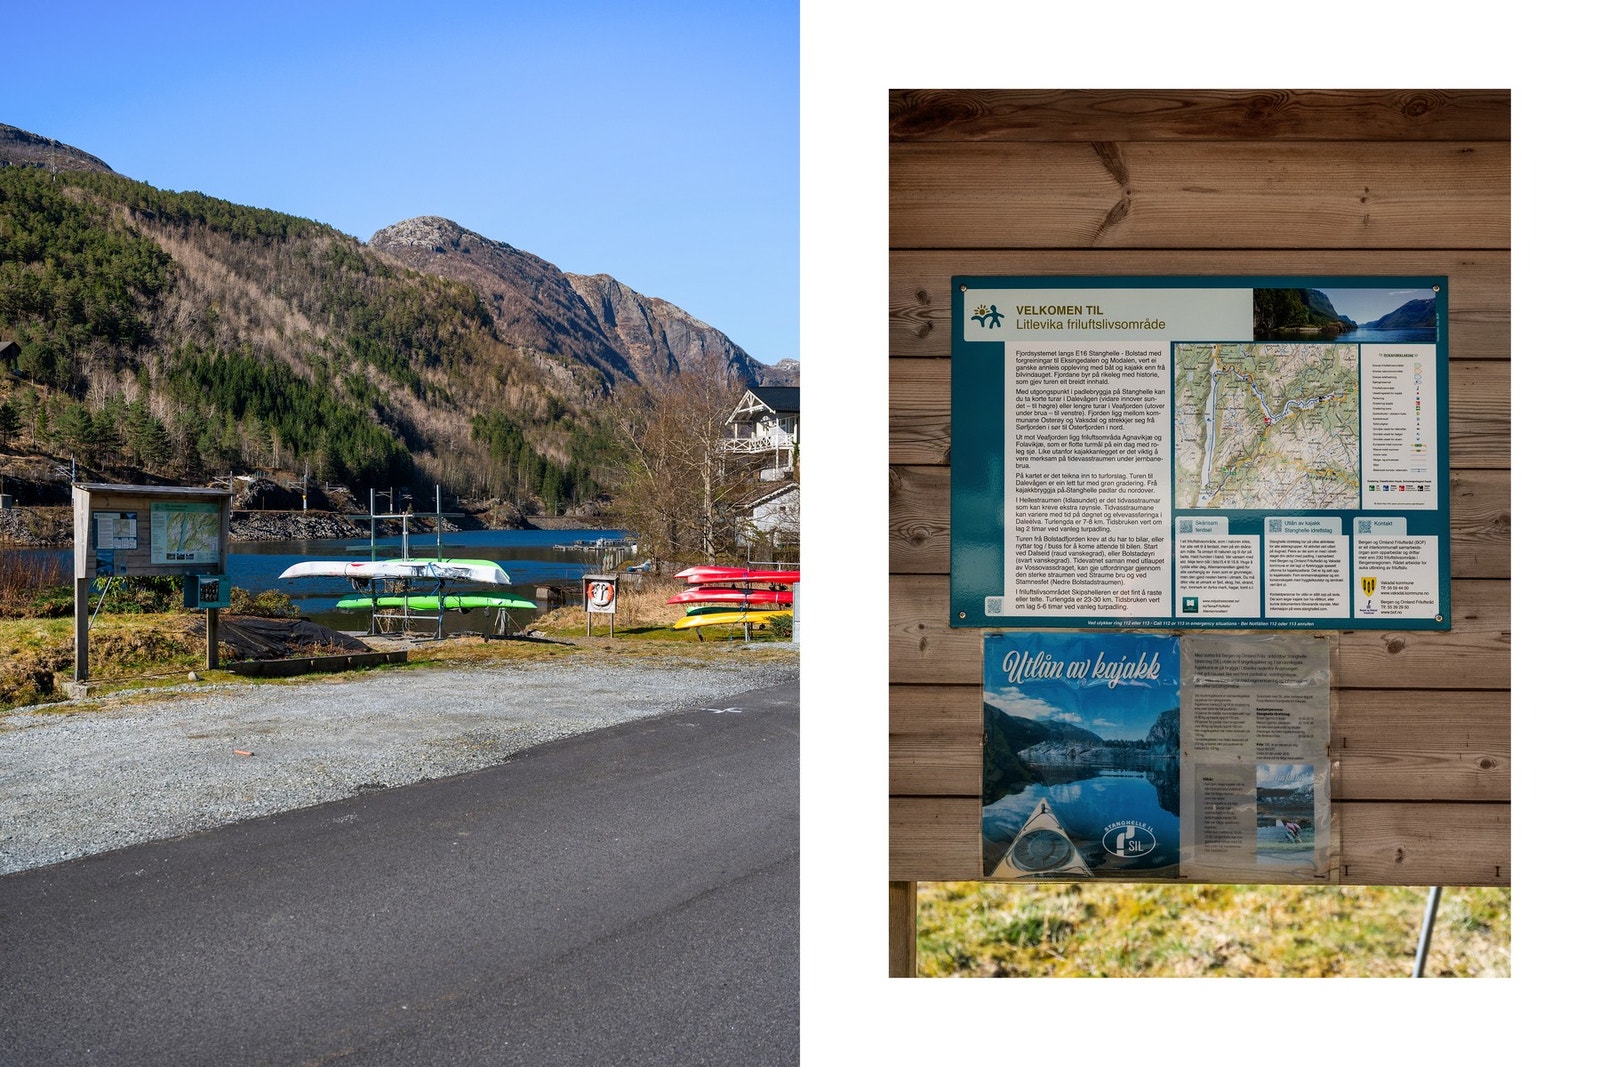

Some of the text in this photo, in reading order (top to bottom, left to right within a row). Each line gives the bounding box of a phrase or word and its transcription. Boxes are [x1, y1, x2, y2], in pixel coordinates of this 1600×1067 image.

[1016, 305, 1104, 315] VELKOMEN TIL
[1016, 318, 1166, 329] Litlevika friluftslivsområde
[1113, 388, 1121, 396] på
[1002, 650, 1064, 684] Utlån
[1067, 658, 1091, 678] av
[1092, 652, 1160, 689] kajakk
[1104, 820, 1146, 832] STANGHELLE
[1128, 840, 1144, 852] SIL
